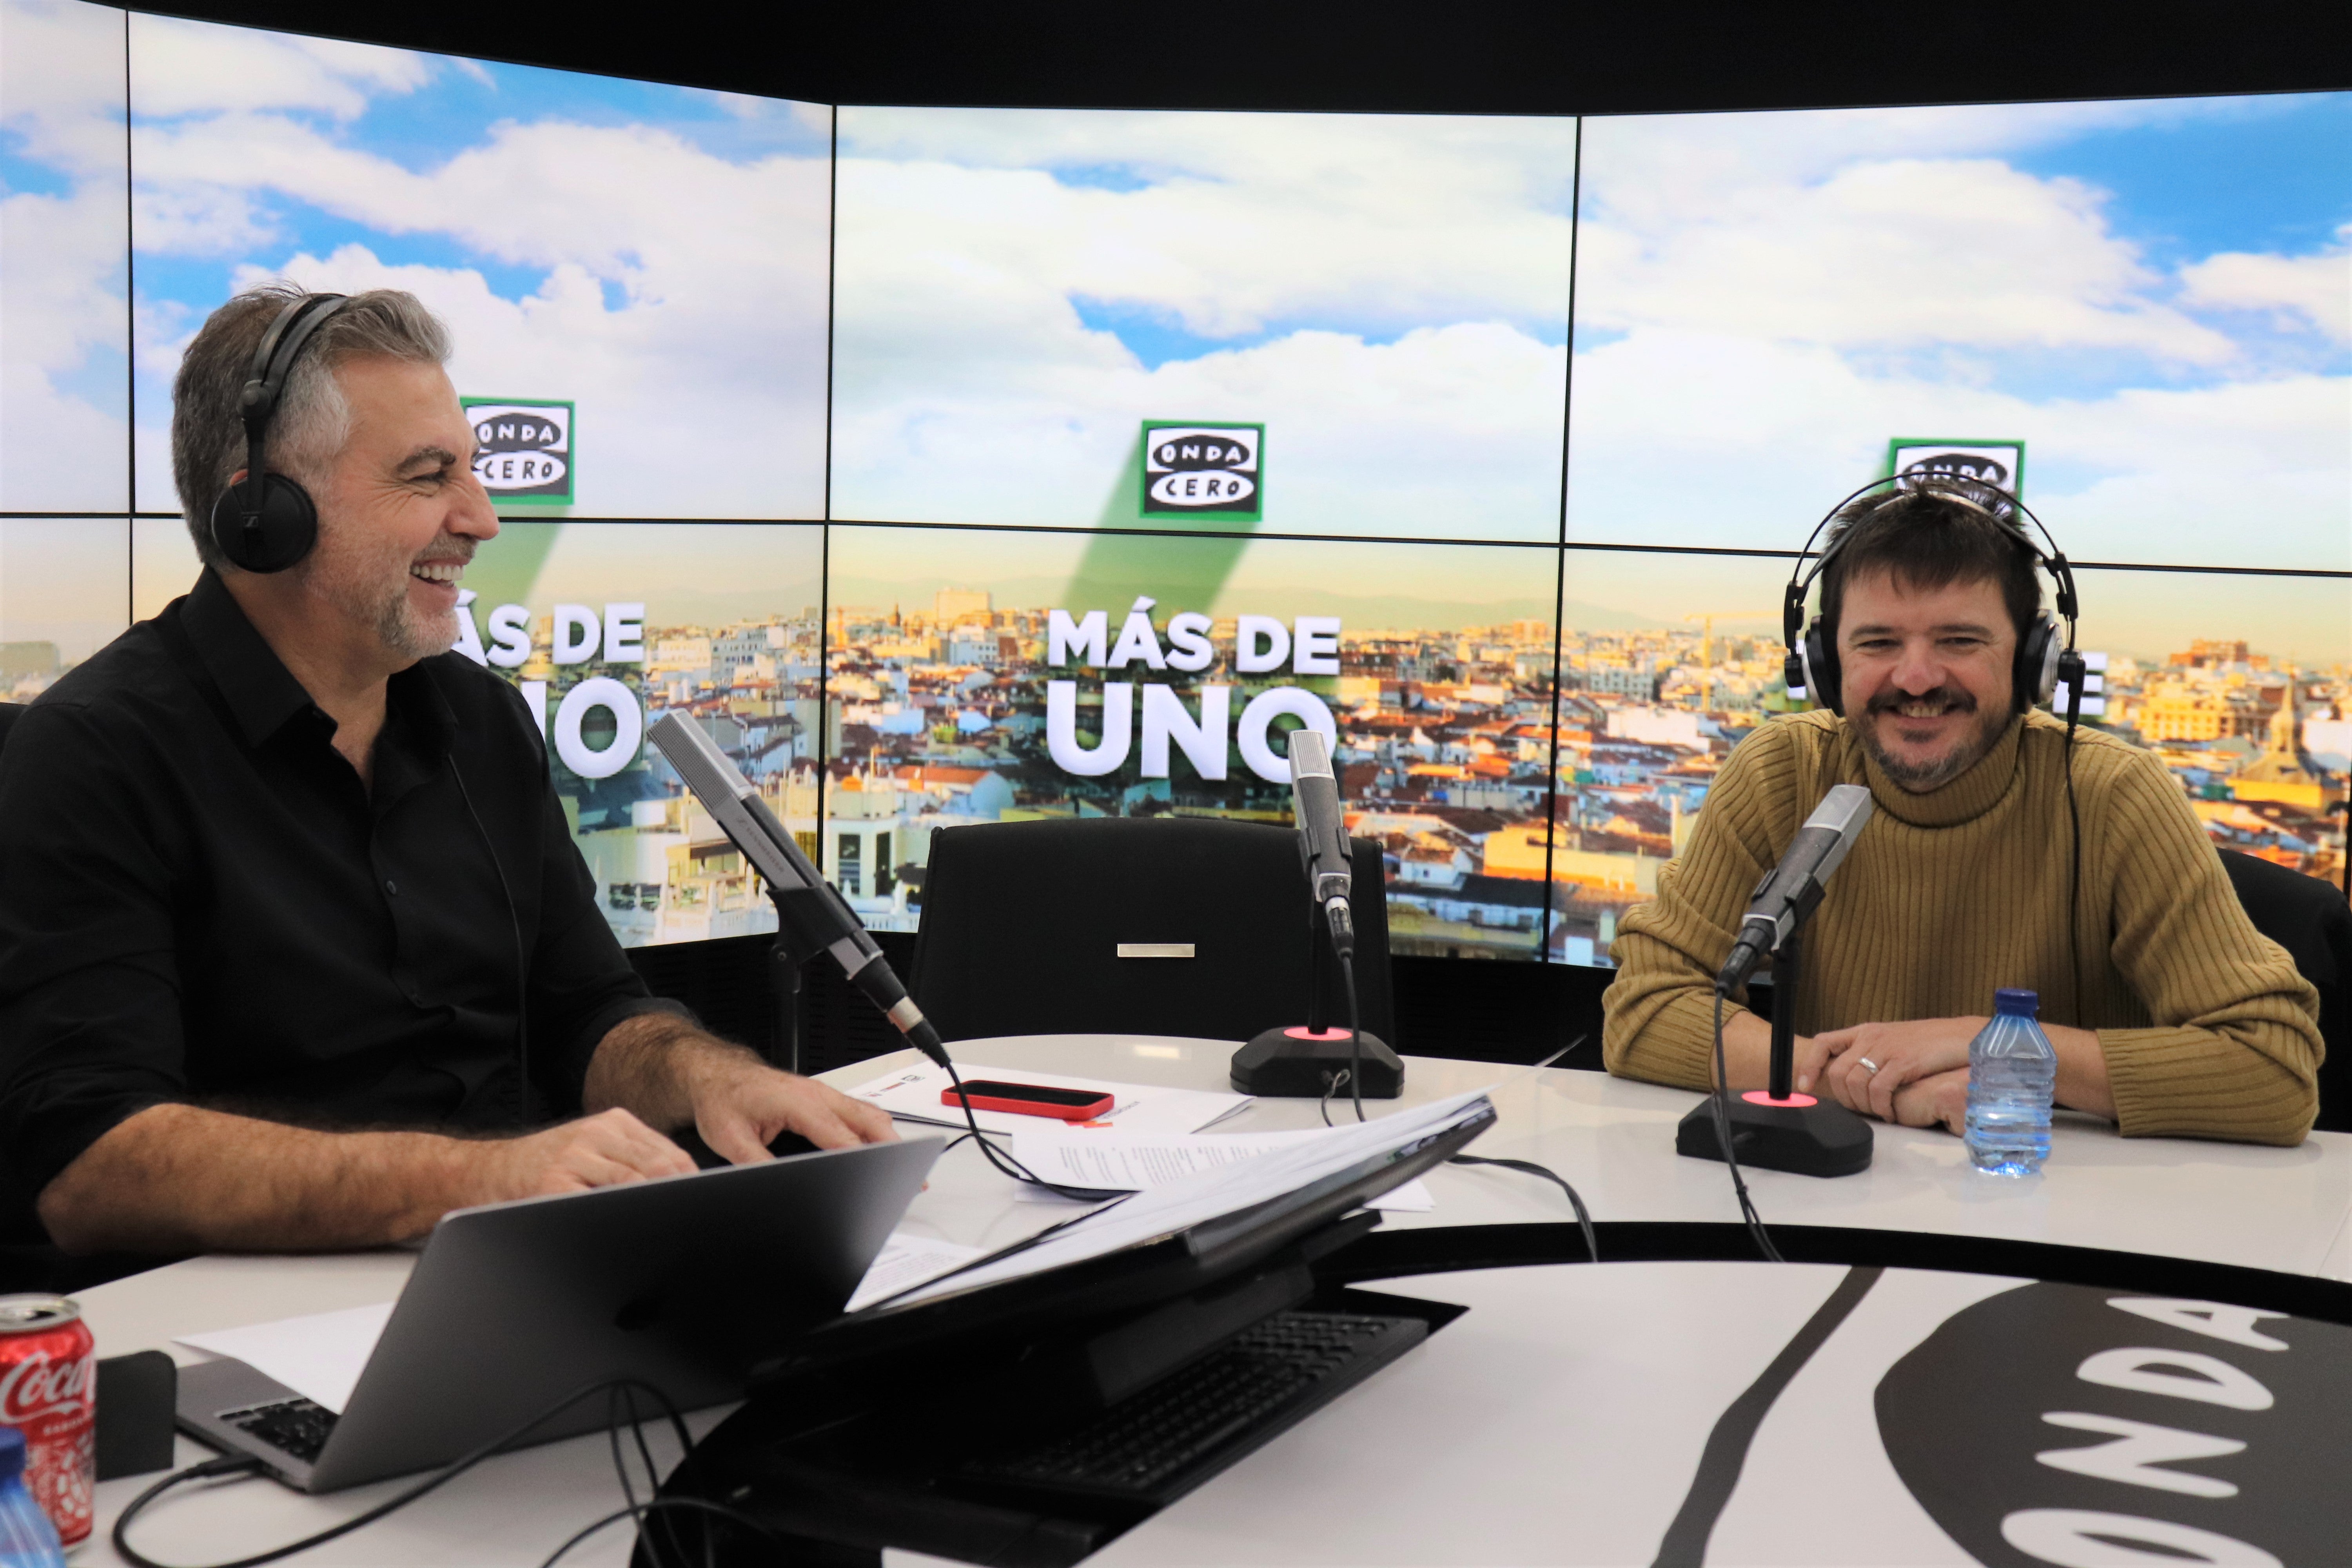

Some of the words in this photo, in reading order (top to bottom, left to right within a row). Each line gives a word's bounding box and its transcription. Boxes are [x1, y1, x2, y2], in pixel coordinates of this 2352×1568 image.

[477, 423, 554, 443] ONDA
[1161, 444, 1241, 463] ONDA
[483, 459, 552, 479] CERO
[1165, 478, 1240, 496] CERO
[552, 602, 645, 665] DE
[1047, 595, 1214, 671] MÁS
[1236, 614, 1341, 675] DE
[1046, 680, 1337, 784] UNO
[2000, 1296, 2290, 1568] ONDA
